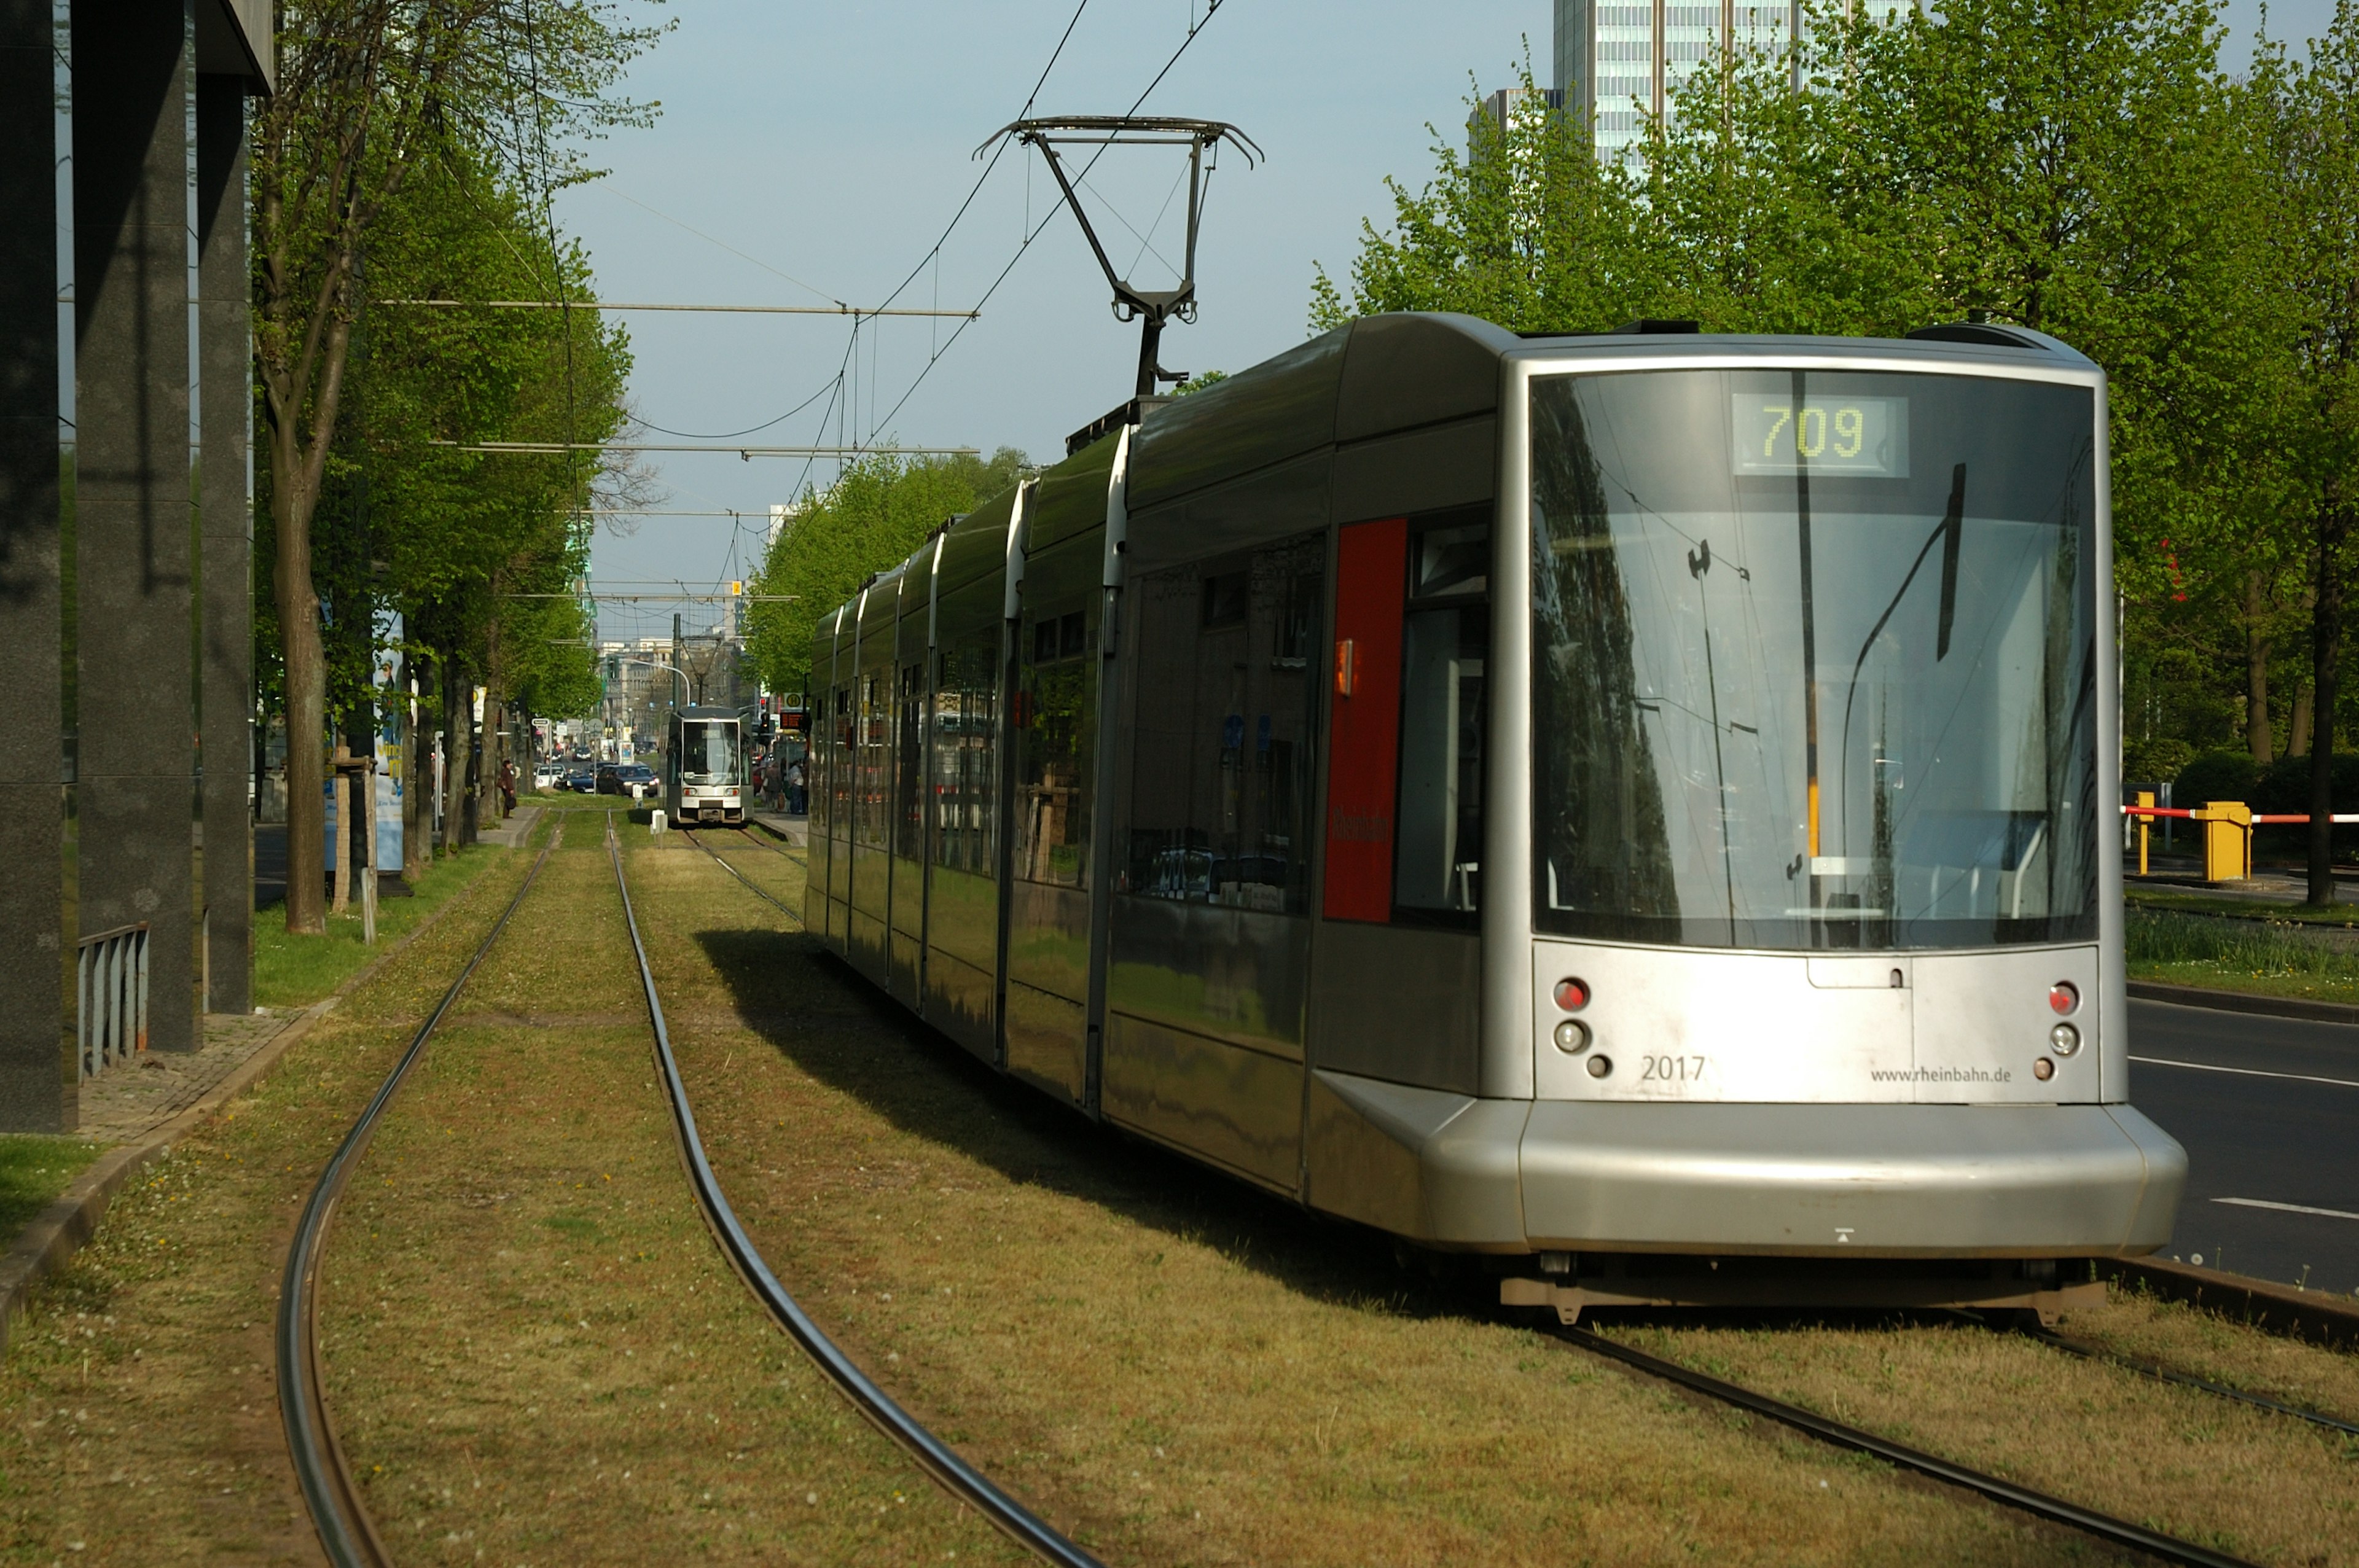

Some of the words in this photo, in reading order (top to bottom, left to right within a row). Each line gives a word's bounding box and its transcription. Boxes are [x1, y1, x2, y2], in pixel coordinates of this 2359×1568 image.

[1763, 405, 1863, 458] 709
[1641, 1055, 1705, 1081] 2017
[1871, 1066, 2012, 1083] www.rheinbahn.de
